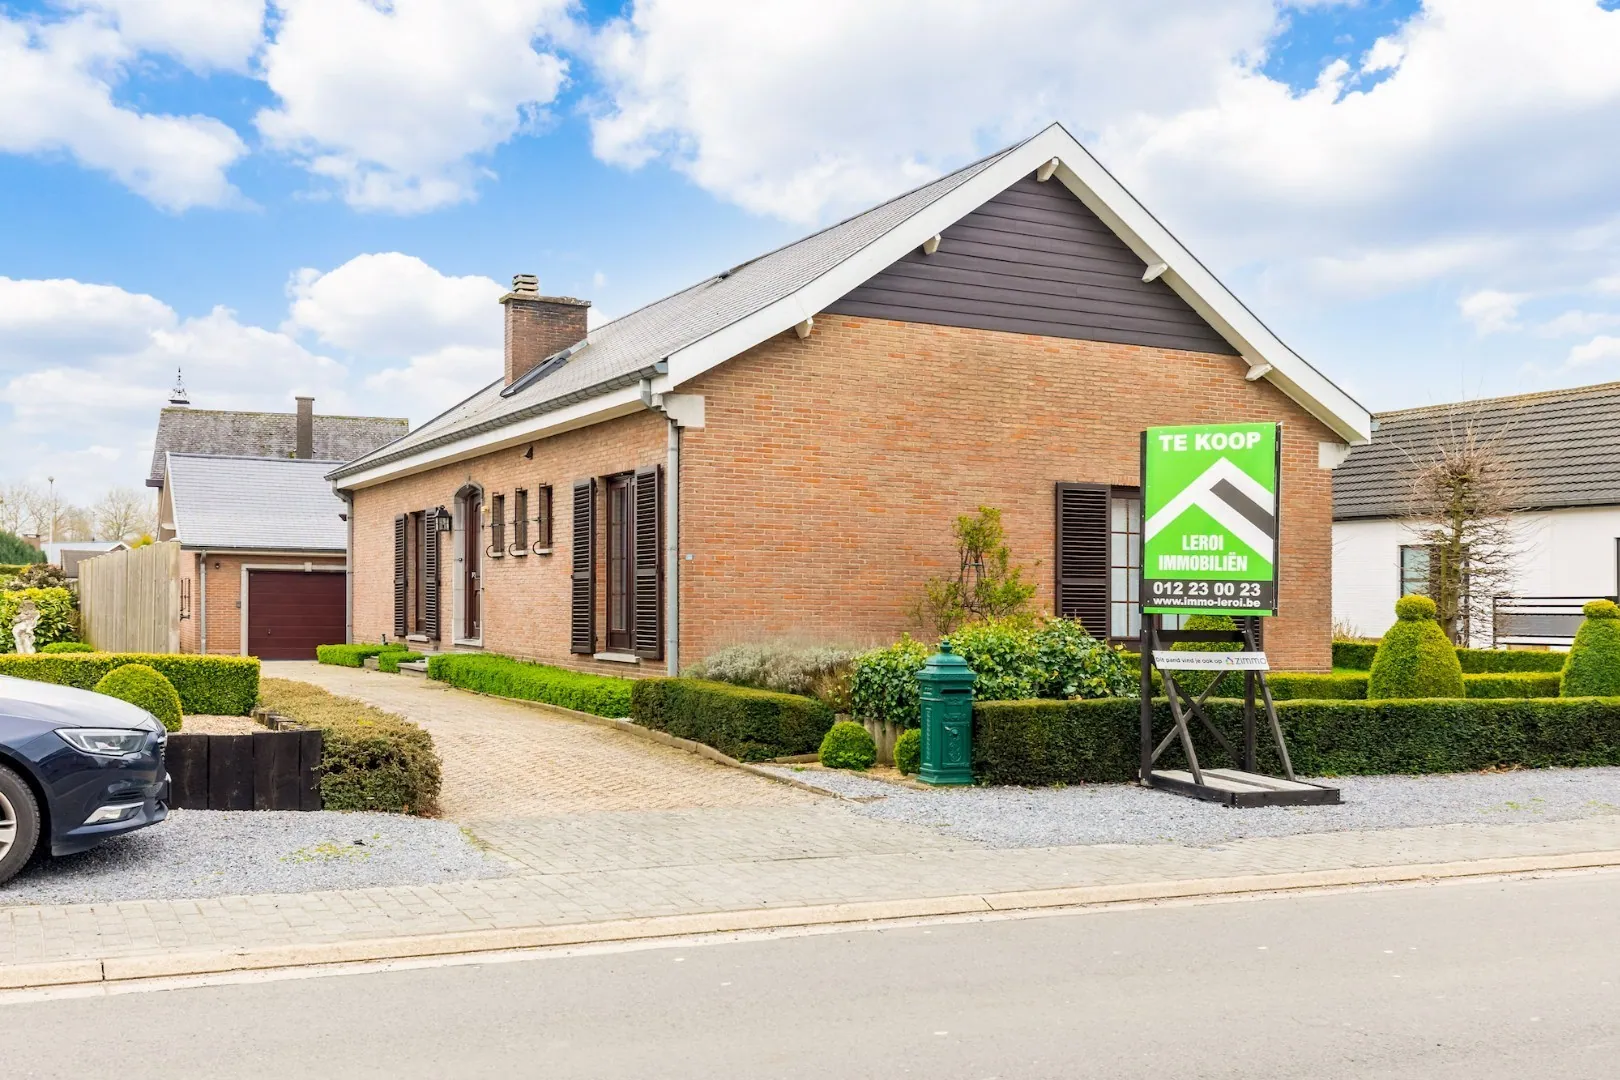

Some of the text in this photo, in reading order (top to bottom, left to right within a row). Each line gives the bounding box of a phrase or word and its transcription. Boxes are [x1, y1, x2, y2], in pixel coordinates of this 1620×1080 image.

[1158, 431, 1261, 452] TE KOOP
[1182, 535, 1224, 551] LEROI
[1158, 552, 1248, 572] IMMOBILIËN
[1153, 581, 1261, 597] 012 23 00 23
[1153, 597, 1261, 608] www.immo-leroi.be
